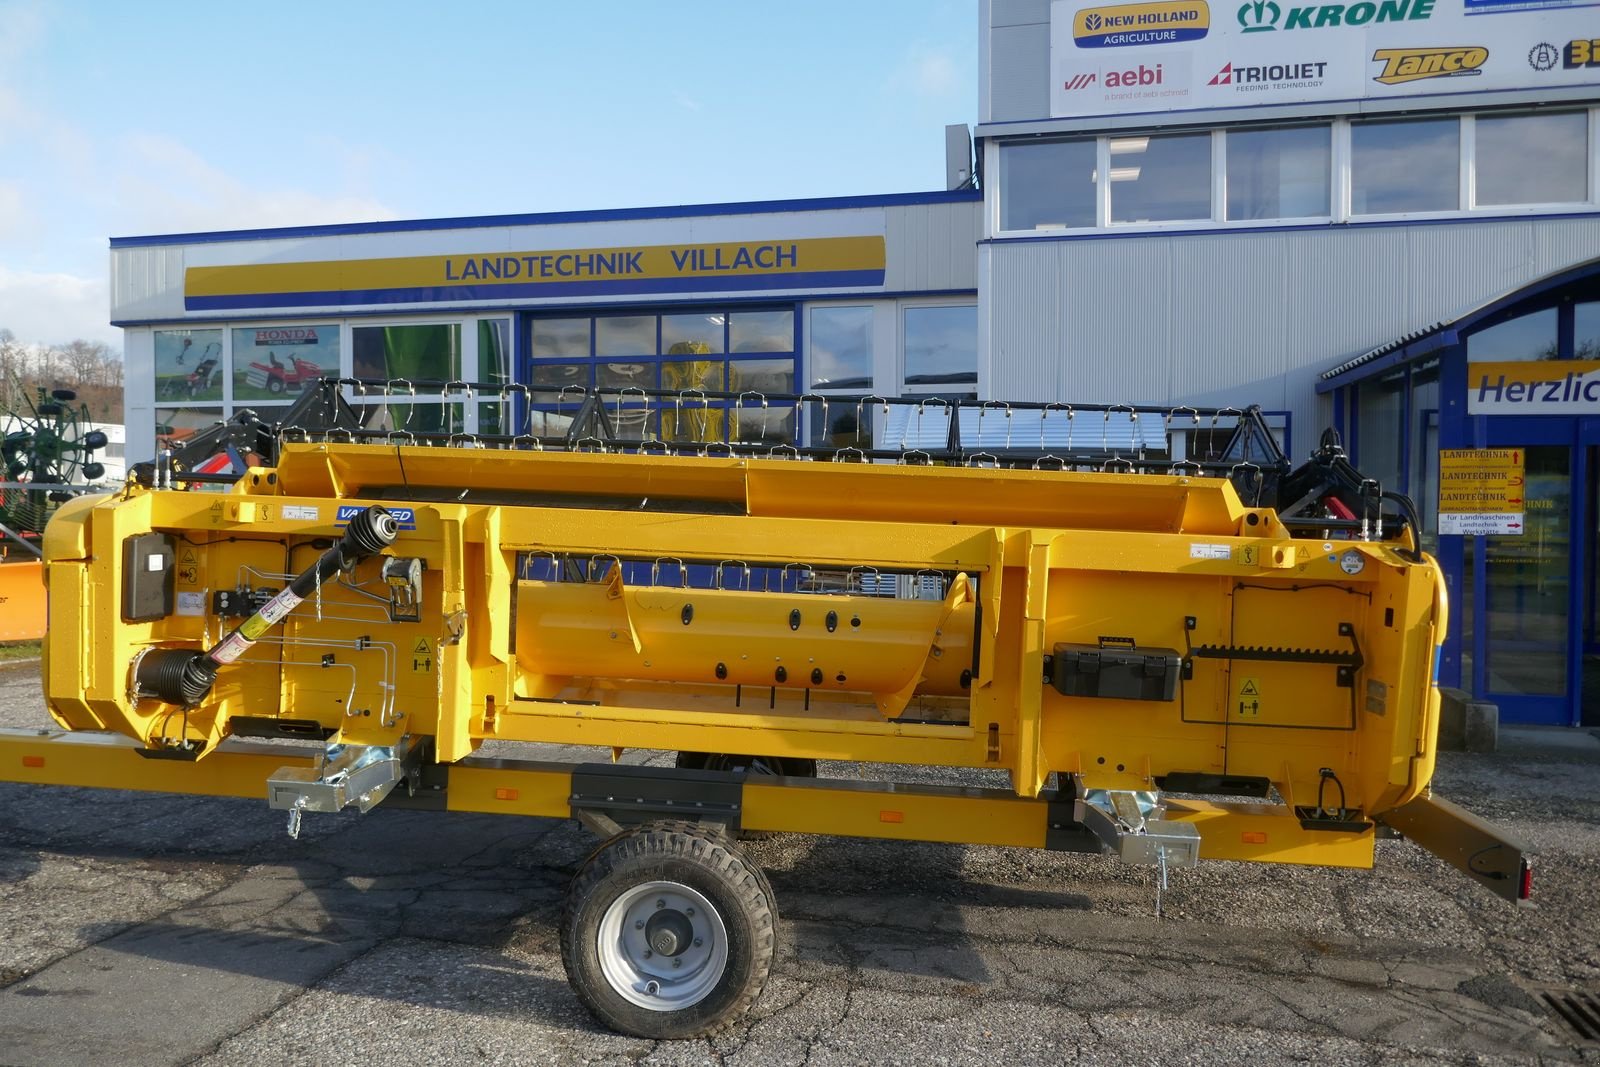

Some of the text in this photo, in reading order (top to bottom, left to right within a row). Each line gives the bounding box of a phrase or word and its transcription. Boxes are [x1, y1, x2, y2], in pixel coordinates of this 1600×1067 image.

[1105, 10, 1199, 27] NEW HOLLAND
[1284, 0, 1436, 30] KRONE
[1103, 31, 1176, 45] AGRICULTURE
[1372, 46, 1489, 82] Tanco
[1105, 64, 1162, 88] aebi
[1233, 62, 1328, 83] TRIOLIET
[1236, 81, 1324, 92] FEEDING TECHNOLOGY
[445, 244, 797, 281] LANDTECHNIK VILLACH
[255, 328, 318, 340] HONDA
[1443, 450, 1509, 459] LANDTECHNIK
[1441, 472, 1508, 480] LANDTECHNIK
[1440, 493, 1506, 501] LANDTECHNIK
[1345, 556, 1359, 564] OK
